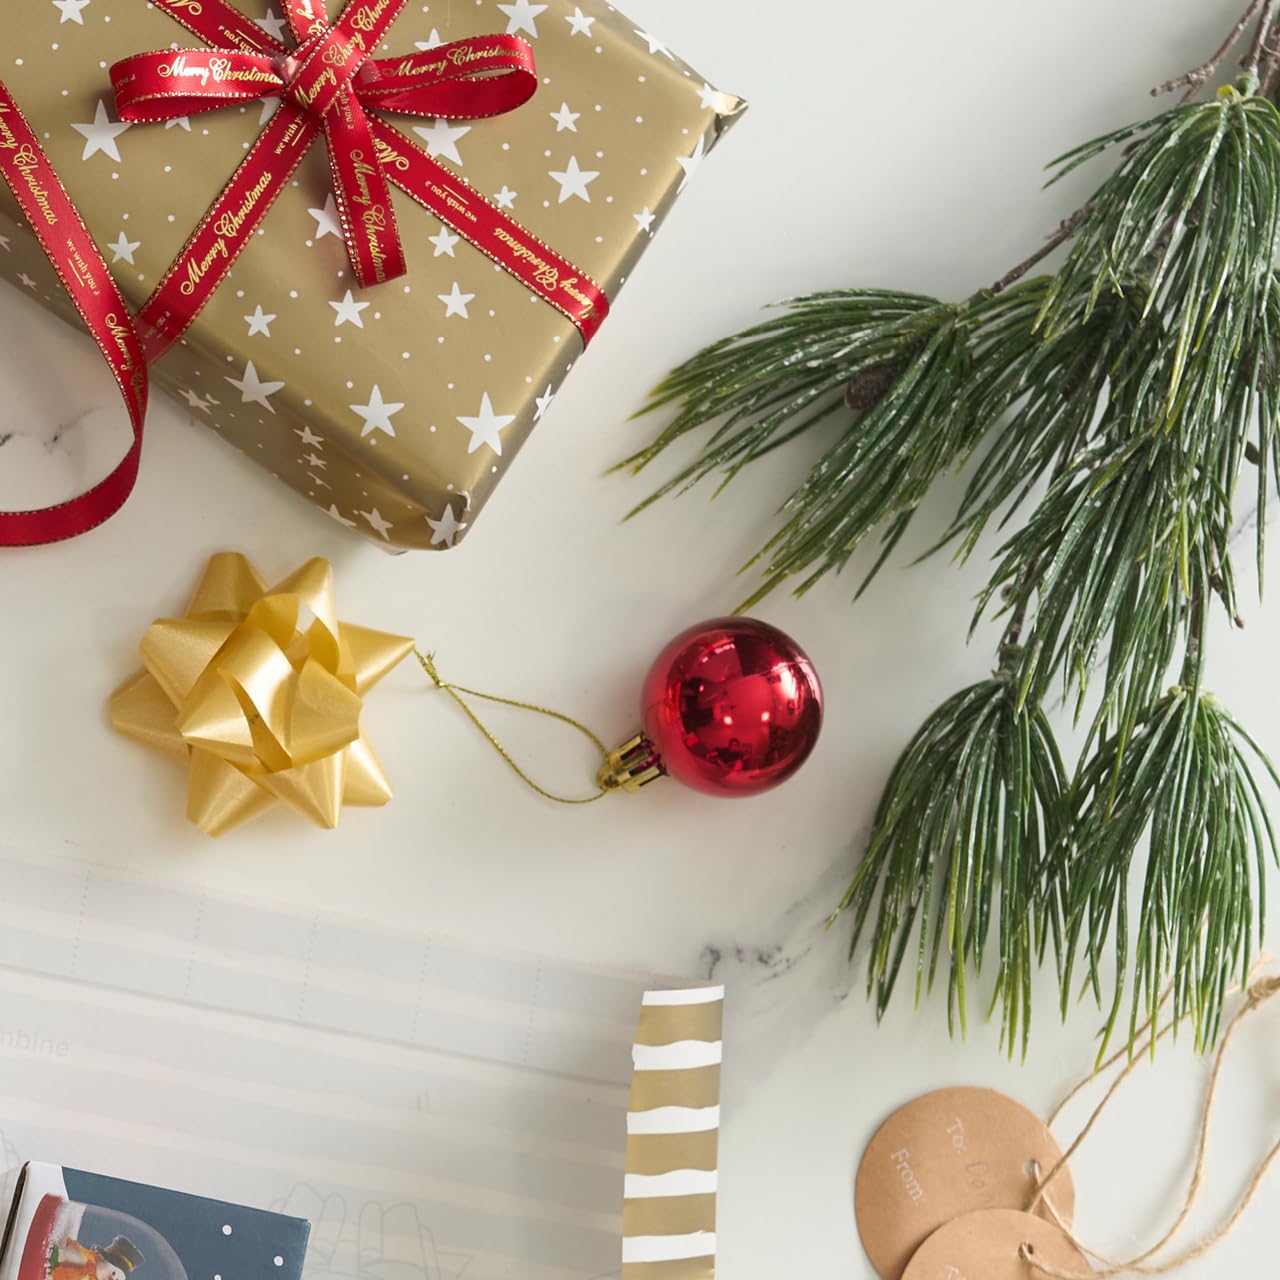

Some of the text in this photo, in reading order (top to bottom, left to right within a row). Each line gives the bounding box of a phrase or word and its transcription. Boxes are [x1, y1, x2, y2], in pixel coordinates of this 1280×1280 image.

[157, 56, 210, 87] Merry
[382, 58, 448, 78] Merry
[12, 143, 58, 226] Christmas
[349, 149, 377, 207] Merry
[179, 170, 273, 297] Merry Christmas
[493, 227, 559, 291] Christmas
[82, 271, 97, 290] you
